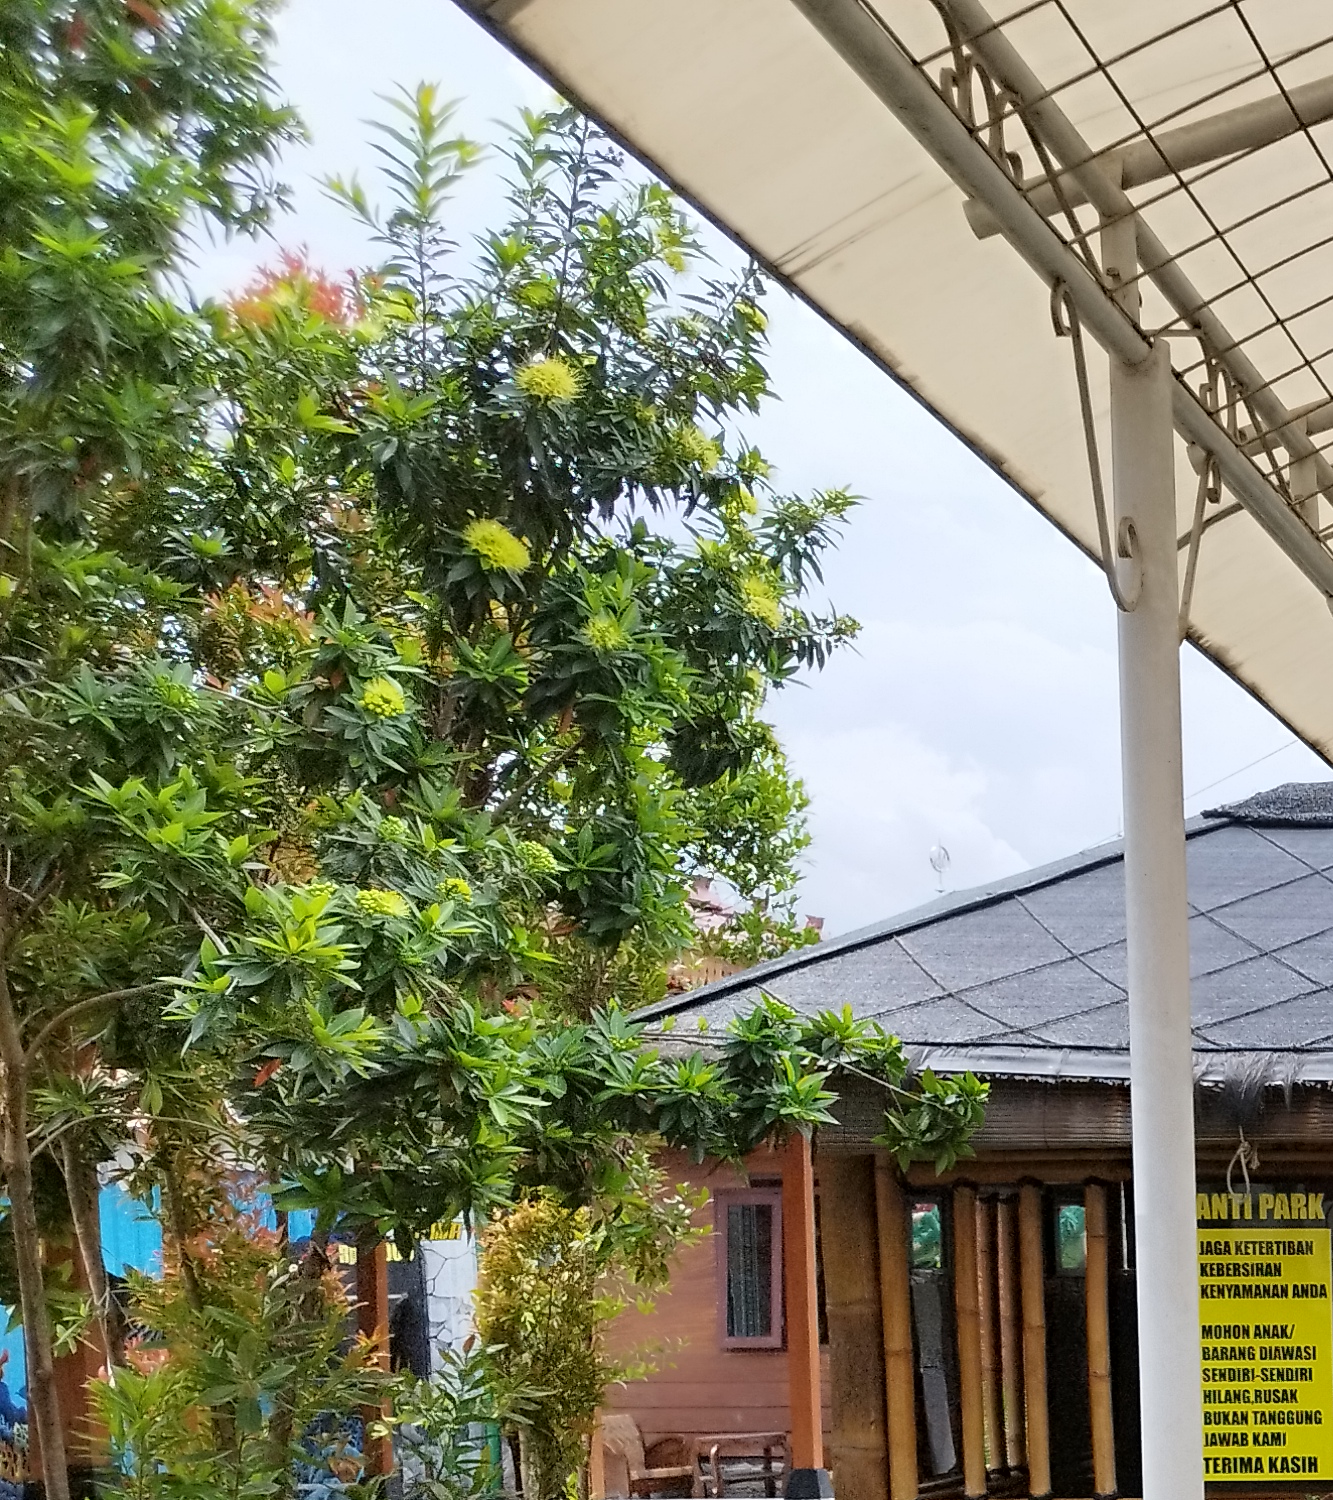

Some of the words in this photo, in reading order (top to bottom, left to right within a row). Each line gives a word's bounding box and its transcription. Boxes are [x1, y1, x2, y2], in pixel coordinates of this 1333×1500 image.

[1196, 1193, 1252, 1220] ANTI
[1259, 1193, 1325, 1220] PARK
[1199, 1241, 1232, 1256] JAGA
[1235, 1241, 1313, 1256] KETERTIBAN
[1200, 1262, 1282, 1277] KEBERSIHAN
[1201, 1284, 1289, 1299] KENYAMANAN
[1292, 1284, 1327, 1299] ANDA
[1201, 1324, 1250, 1339] MOHON
[1253, 1323, 1295, 1339] ANAK/
[1202, 1346, 1255, 1361] BARANG
[1259, 1345, 1317, 1361] DIAWASI
[1202, 1367, 1313, 1382] SENDIRI-SENDIRI
[1203, 1410, 1249, 1425] BUKAN
[1252, 1410, 1322, 1425] TANGGUNG
[1204, 1432, 1249, 1447] JAWAB
[1252, 1432, 1286, 1447] KAMI
[1203, 1457, 1265, 1474] TERIMA
[1268, 1456, 1318, 1473] KASIH
